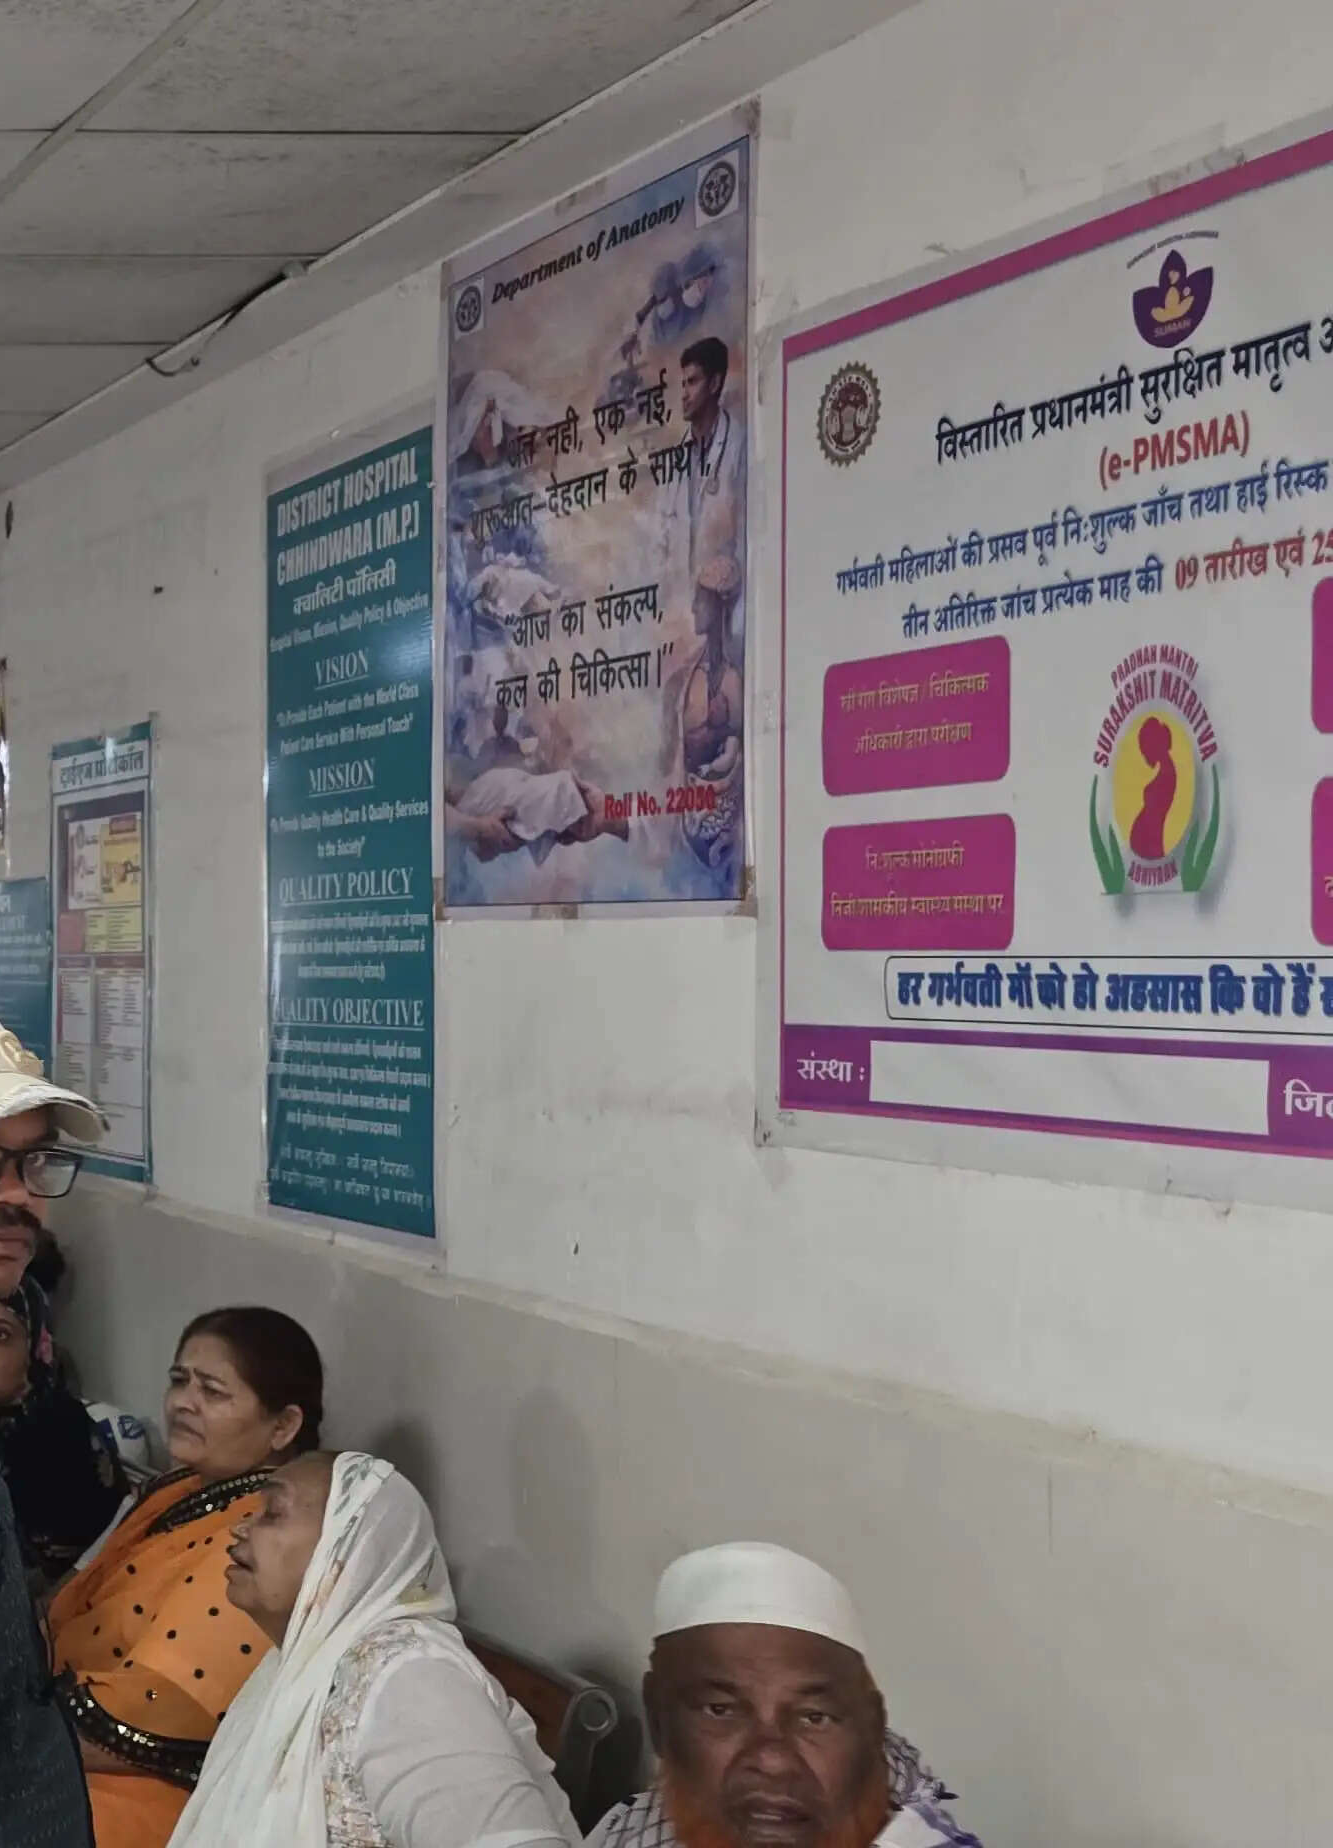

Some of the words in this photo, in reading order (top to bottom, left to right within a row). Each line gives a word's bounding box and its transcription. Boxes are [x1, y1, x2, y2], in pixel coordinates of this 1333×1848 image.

[492, 245, 584, 304] Department
[585, 231, 606, 261] of
[606, 196, 685, 251] Anatomy
[935, 401, 1025, 464] विस्तारित
[1030, 364, 1133, 439] प्रधानमंत्री
[1138, 348, 1225, 425] सुरक्षित
[1231, 320, 1311, 392] मातृत्व
[593, 406, 625, 444] एक
[1098, 410, 1250, 491] (e-PMSMA)
[277, 478, 341, 537] DISTRICT
[343, 447, 418, 510] HOSPITAL
[618, 446, 638, 494] के
[277, 518, 373, 586] CHHINDWARA
[376, 501, 420, 550] (M.P.)
[836, 552, 886, 595] गर्भवती
[888, 535, 960, 583] महिलाओं
[960, 528, 985, 569] की
[987, 528, 1028, 565] प्रसव
[1031, 510, 1058, 566] पूर्व
[1141, 484, 1183, 527] जाँच
[1188, 482, 1231, 520] तथा
[1234, 460, 1270, 514] हाई
[1273, 458, 1329, 500] रिस्क
[902, 601, 929, 639] तीन
[933, 591, 998, 633] अतिरिक्त
[1001, 584, 1037, 620] जांच
[1042, 569, 1093, 614] प्रत्येक
[1098, 569, 1132, 600] माह
[1134, 554, 1164, 595] की
[1175, 554, 1199, 591] 09
[1204, 536, 1270, 584] तारीख
[1273, 527, 1305, 579] एवं
[560, 601, 586, 638] का
[315, 649, 369, 685] VISION
[495, 675, 528, 709] कल
[537, 657, 561, 704] की
[1111, 645, 1157, 689] PRADHAN
[1159, 644, 1199, 681] MANTRI
[1094, 669, 1156, 768] SURAKSHIT
[1159, 669, 1218, 763] MATRITVA
[309, 758, 376, 793] MISSION
[605, 792, 632, 819] Roll
[636, 790, 661, 816] No.
[279, 872, 344, 902] QUALITY
[347, 866, 413, 898] POLICY
[333, 998, 425, 1027] OBJECTIVE
[897, 970, 923, 1009] हर
[928, 961, 1002, 1009] गर्भवती
[1036, 961, 1068, 1011] को
[1072, 961, 1099, 1014] हो
[1105, 973, 1203, 1016] अहसास
[1208, 963, 1245, 1017] कि
[1251, 962, 1285, 1017] वो
[1286, 961, 1316, 1017] हैं
